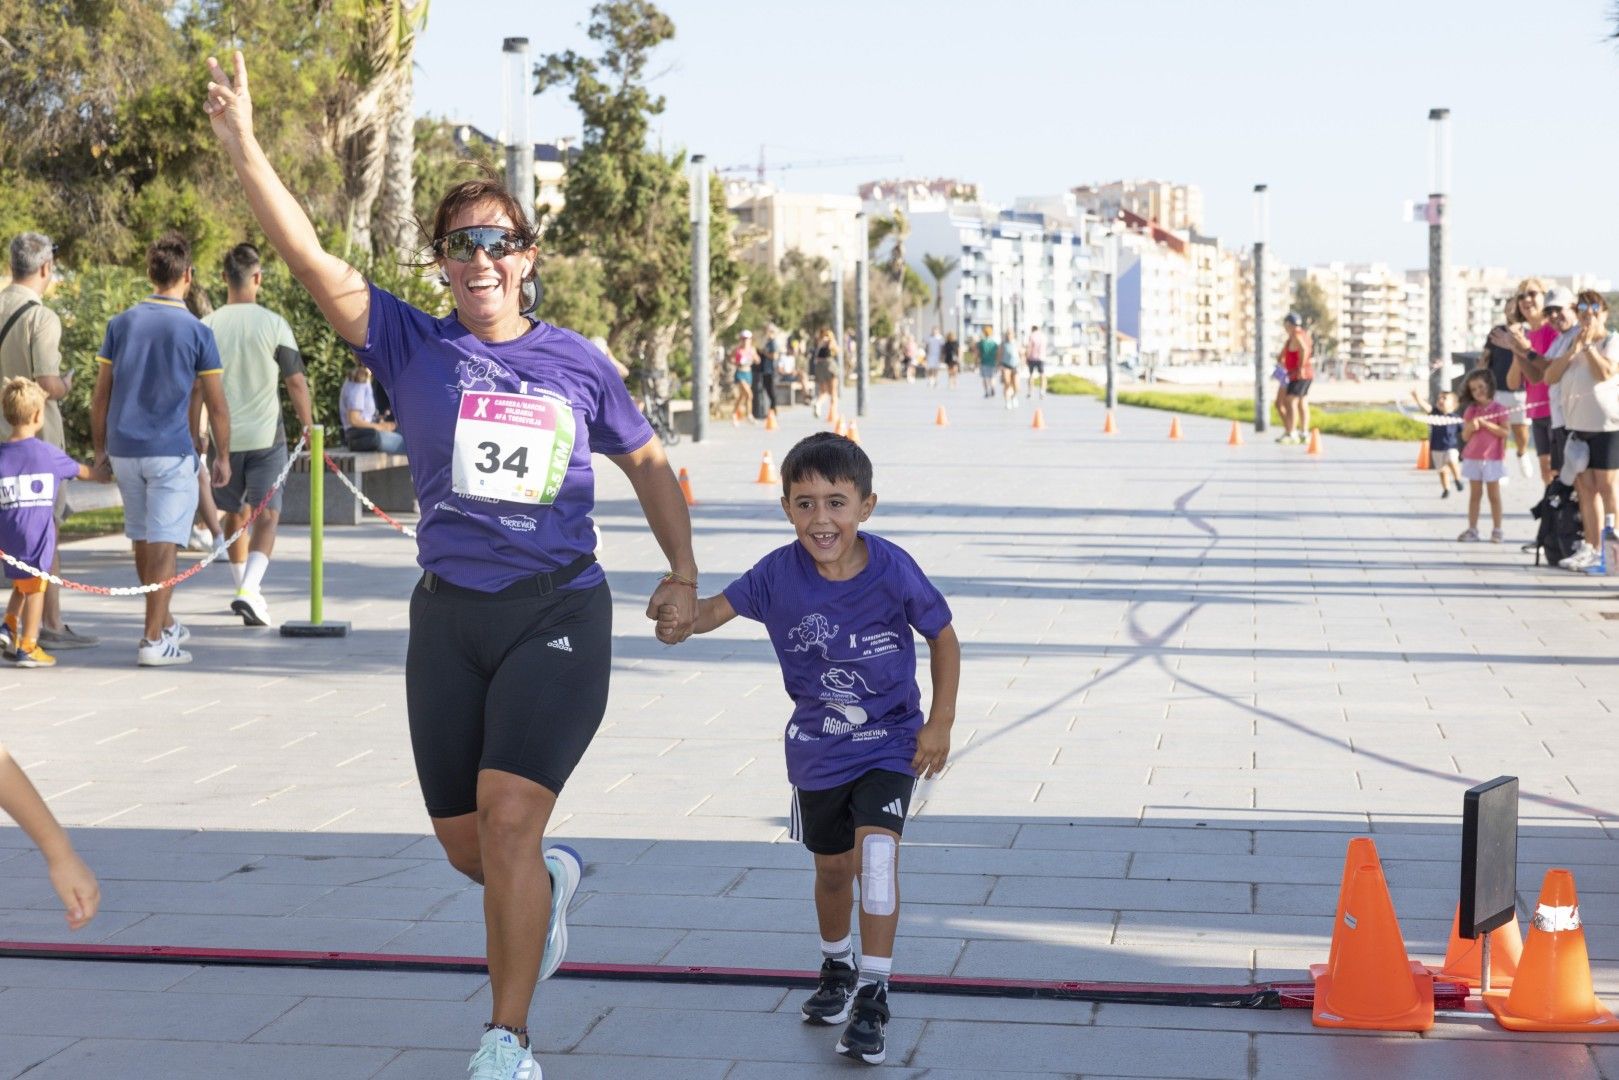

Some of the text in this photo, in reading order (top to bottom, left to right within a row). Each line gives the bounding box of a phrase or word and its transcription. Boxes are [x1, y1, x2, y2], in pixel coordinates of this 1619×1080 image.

[473, 397, 491, 418] X
[494, 413, 507, 421] AFA
[475, 441, 529, 478] 34
[551, 439, 571, 471] KM
[547, 641, 573, 652] adidas
[849, 634, 857, 648] X
